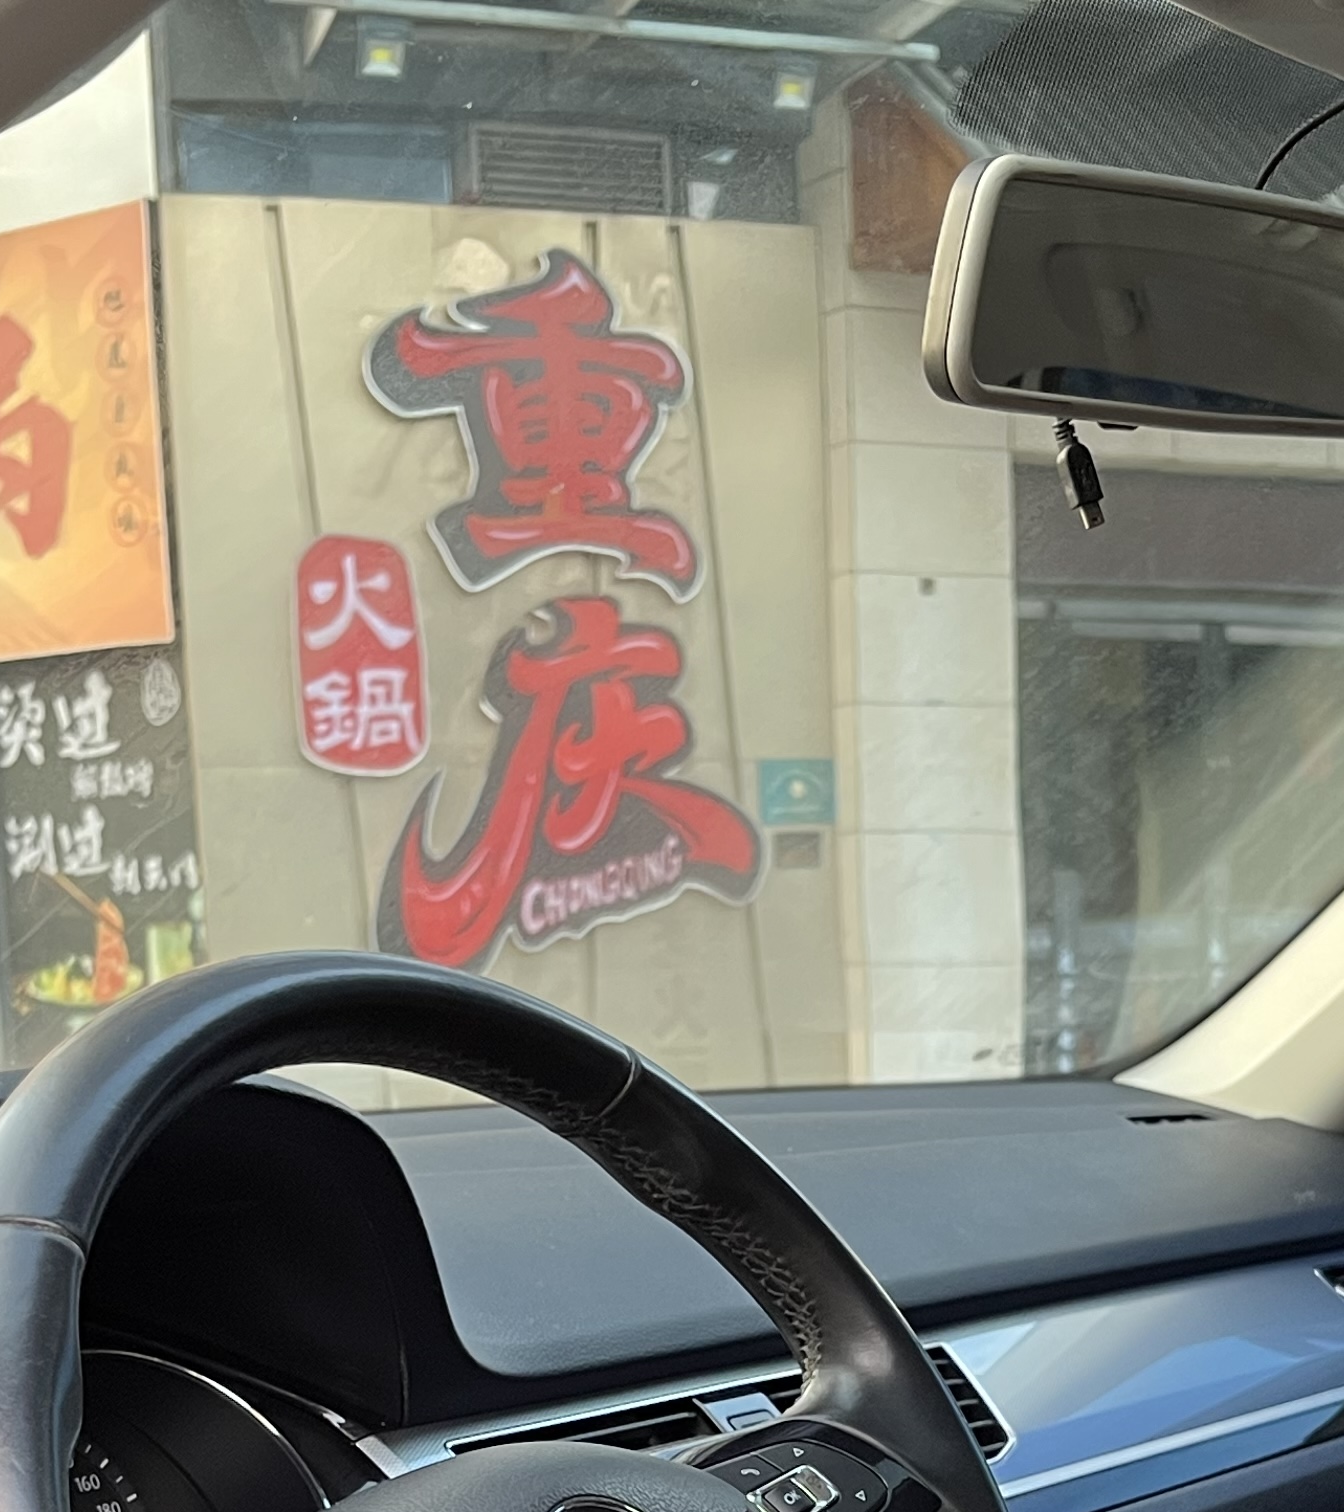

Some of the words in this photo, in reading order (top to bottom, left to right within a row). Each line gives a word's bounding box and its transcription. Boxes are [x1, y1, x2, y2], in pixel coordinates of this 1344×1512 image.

[304, 552, 420, 754] 火鍋
[384, 252, 758, 966] 重庆
[74, 1473, 101, 1493] 160
[783, 1489, 802, 1505] OK
